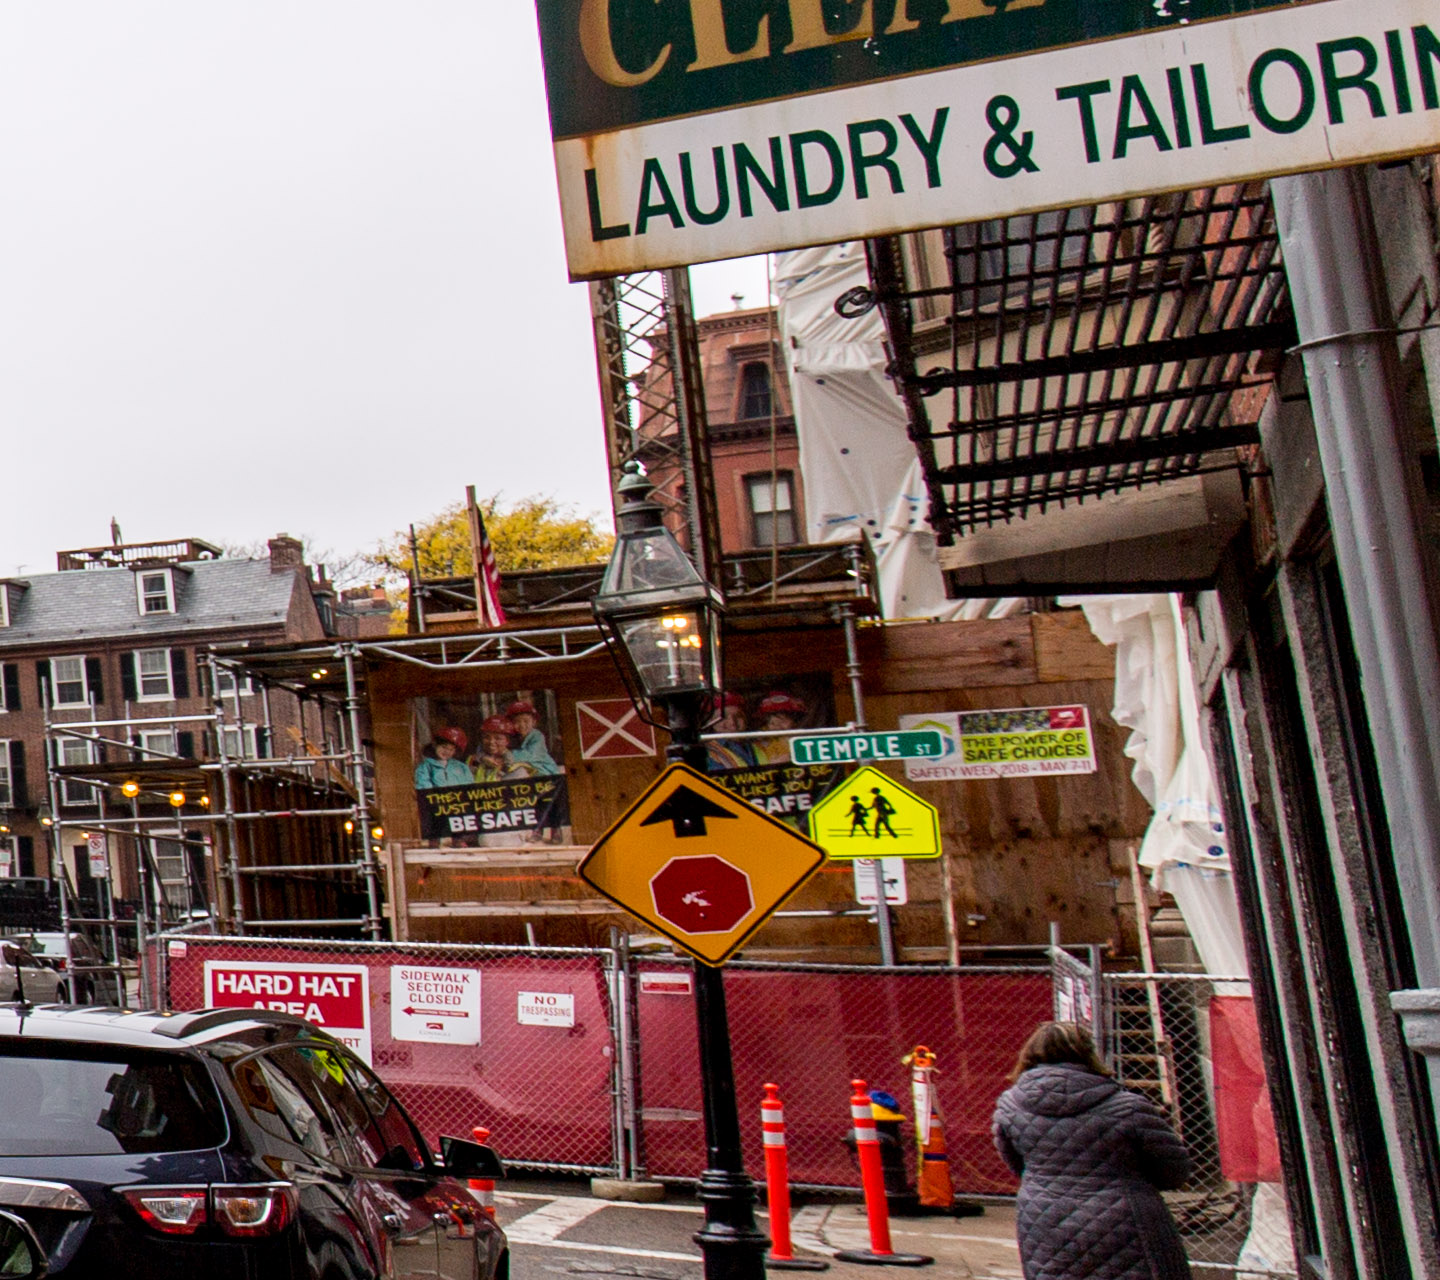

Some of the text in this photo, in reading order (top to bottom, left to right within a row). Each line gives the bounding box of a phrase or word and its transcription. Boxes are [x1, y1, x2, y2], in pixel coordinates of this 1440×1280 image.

[584, 106, 949, 243] LAUNDRY
[983, 94, 1040, 180] &
[800, 736, 931, 762] TEMPLE ST
[964, 732, 1084, 748] THE POWER OF
[965, 744, 1087, 761] SAFE CHOICES
[733, 770, 780, 784] WANT
[783, 767, 805, 779] TO
[809, 765, 832, 777] BE
[910, 766, 957, 779] SAFETY
[1000, 763, 1030, 775] 2018
[1041, 762, 1068, 773] MAY
[426, 781, 556, 806] THEY WANT TO BE
[741, 783, 779, 797] LIKE
[781, 779, 813, 793] YOU
[435, 803, 470, 816] JUST
[475, 798, 507, 812] LIKE
[511, 795, 538, 808] YOU
[750, 793, 813, 814] SAFE
[448, 808, 538, 833] BE SAFE
[217, 973, 355, 998] HARD HAT
[400, 969, 470, 984] SIDEWALK
[407, 982, 464, 994] SECTION
[409, 992, 461, 1006] CLOSED
[534, 995, 557, 1006] NO
[521, 1005, 572, 1018] TRESPASSING
